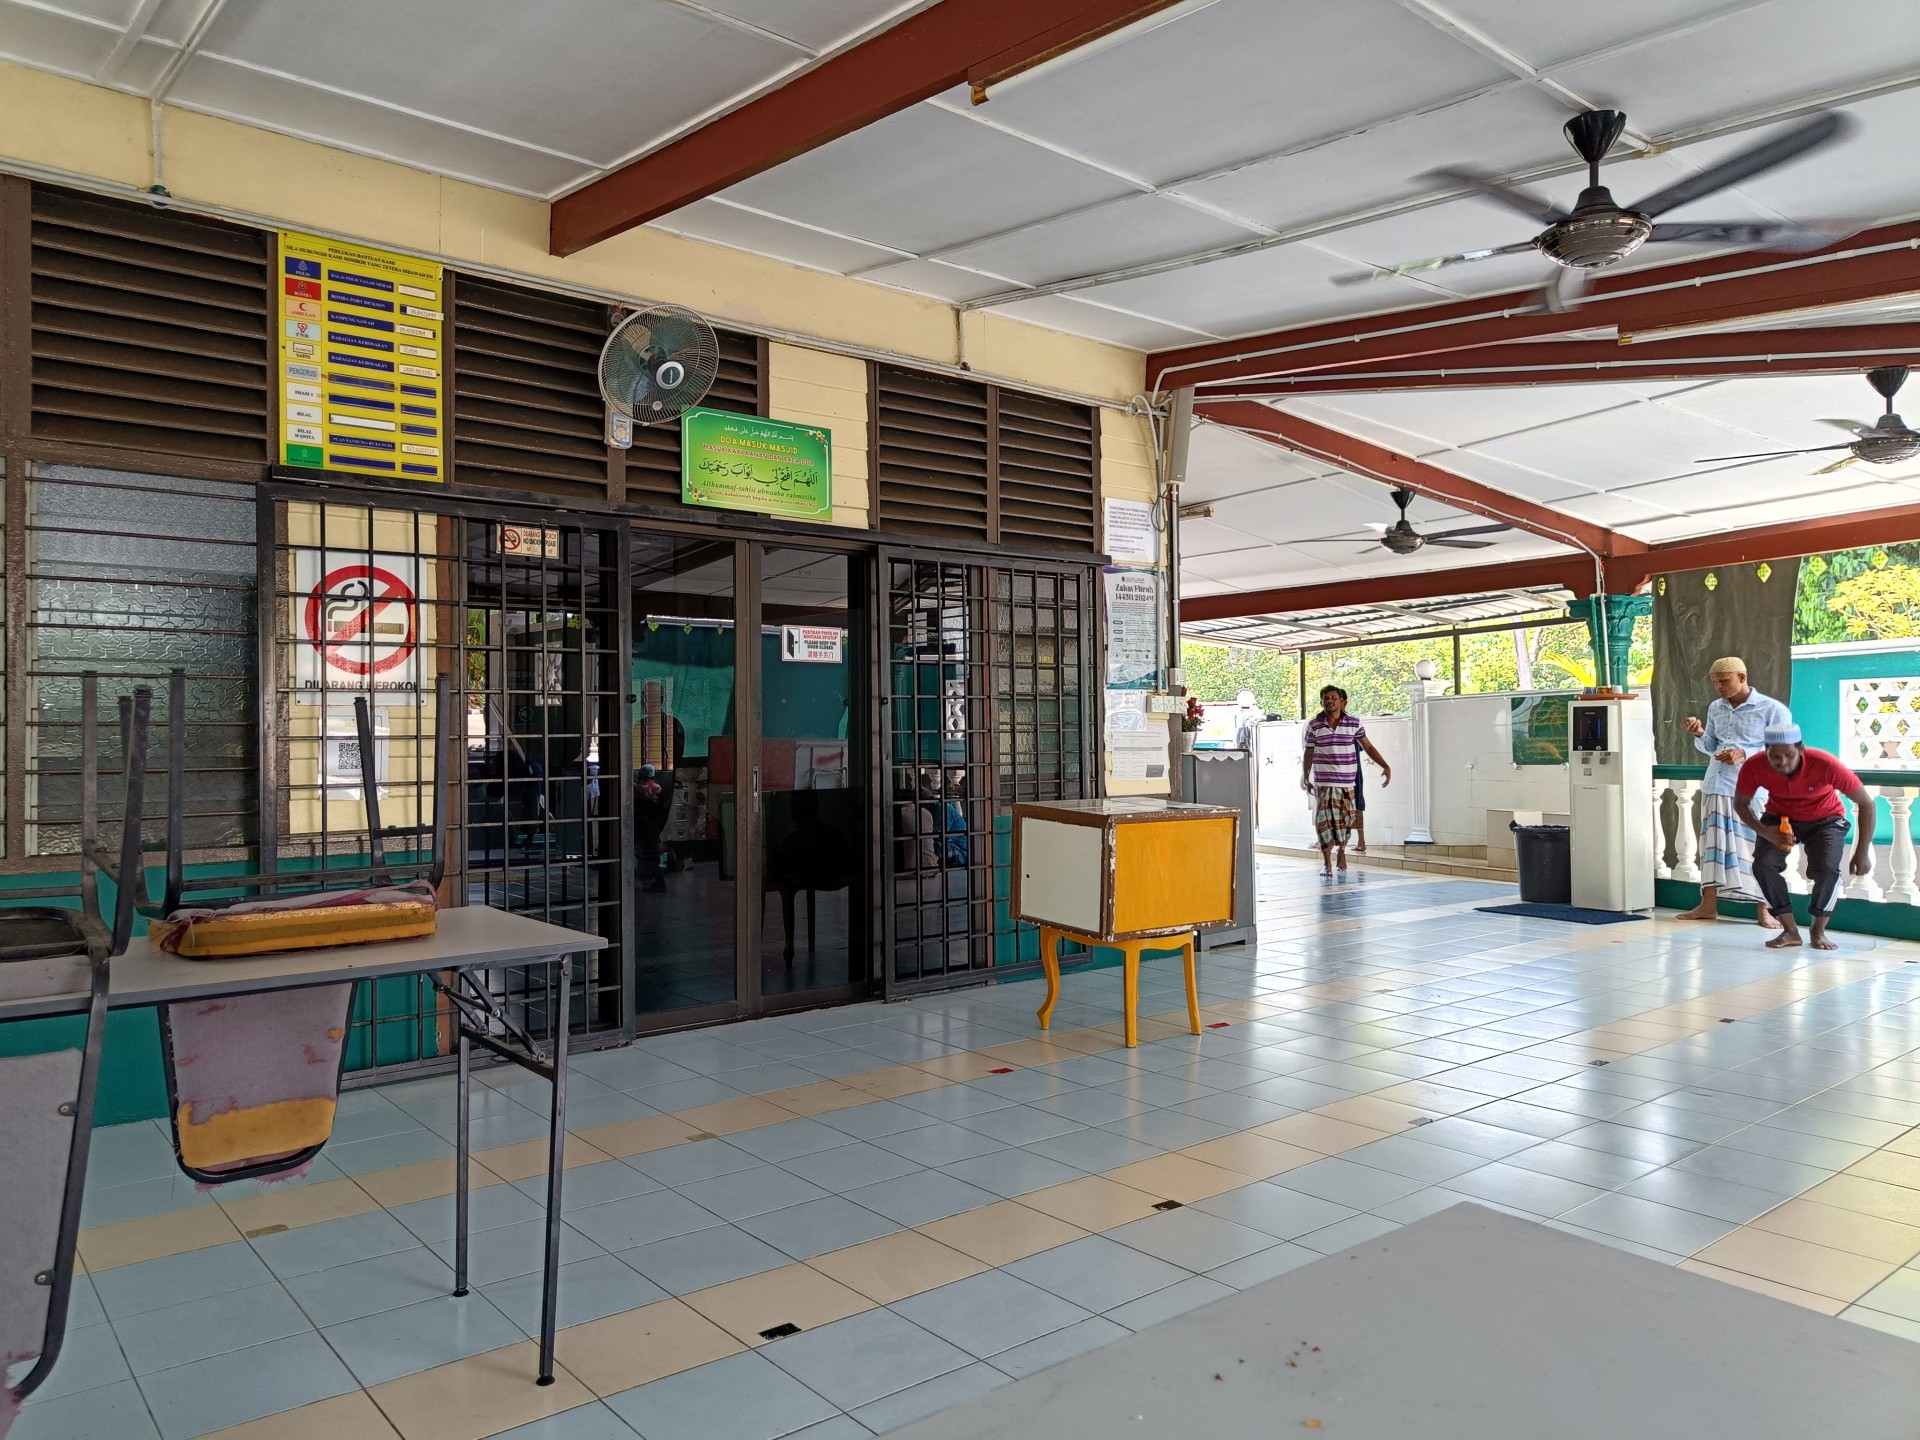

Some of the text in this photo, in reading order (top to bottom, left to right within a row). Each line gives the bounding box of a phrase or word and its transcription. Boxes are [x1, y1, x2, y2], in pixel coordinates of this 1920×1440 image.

[328, 248, 396, 266] PERLUKAN BANTUAN KAMI
[344, 256, 367, 265] NOMBOR
[367, 260, 382, 268] YANG
[294, 290, 313, 298] BOMBA
[291, 310, 316, 318] AMBULAN
[331, 314, 356, 322] KAMPUNG
[331, 335, 388, 348] BAHAGIAN KEROSAKAN
[331, 355, 388, 368] BAHAGIAN KEROSAKAN
[288, 366, 318, 378] PENGERUSI
[720, 436, 798, 454] DOA MASUK MASJID
[703, 444, 726, 452] MASUK
[744, 450, 768, 459] KANAN
[1115, 584, 1154, 593] Zakat Fitrah
